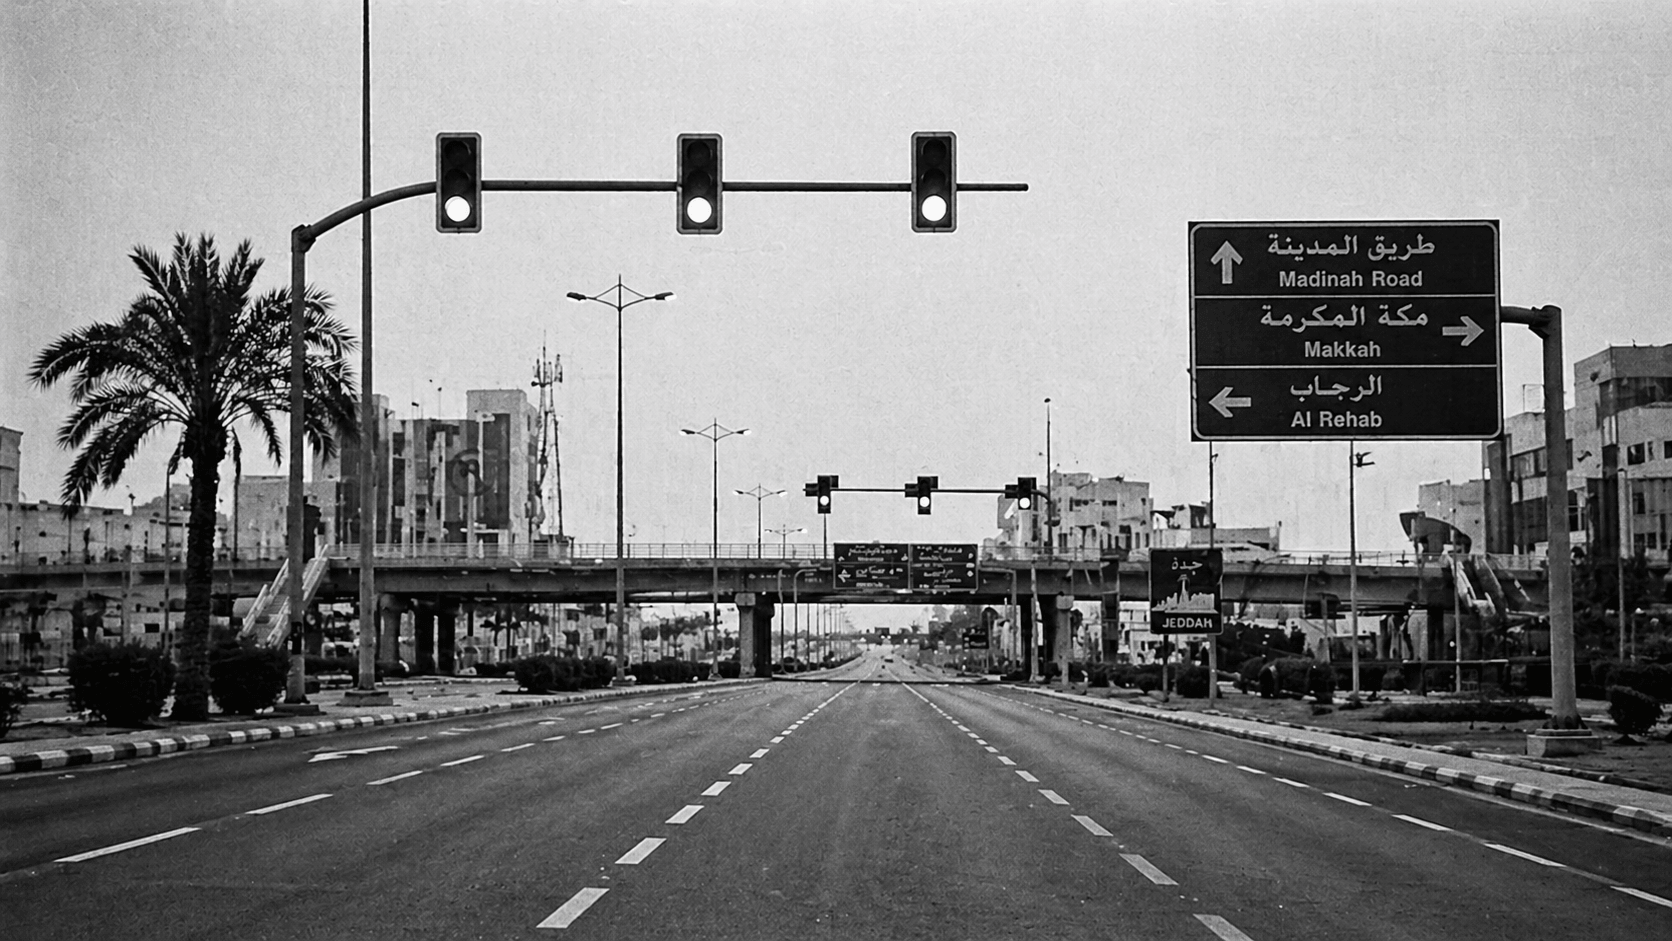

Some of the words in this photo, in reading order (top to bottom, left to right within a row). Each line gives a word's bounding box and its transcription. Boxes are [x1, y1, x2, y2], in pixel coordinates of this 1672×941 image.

[1268, 233, 1358, 262] المدينة
[1368, 233, 1435, 261] طريق
[1279, 271, 1363, 287] Madinah
[1372, 271, 1423, 287] Road
[1260, 304, 1366, 333] المكرمة
[1378, 304, 1429, 326] مكة
[1304, 341, 1381, 358] Makkah
[1291, 411, 1311, 427] Al
[1319, 411, 1382, 427] Rehab
[1171, 557, 1203, 576] جدة
[1162, 617, 1213, 628] JEDDAH
